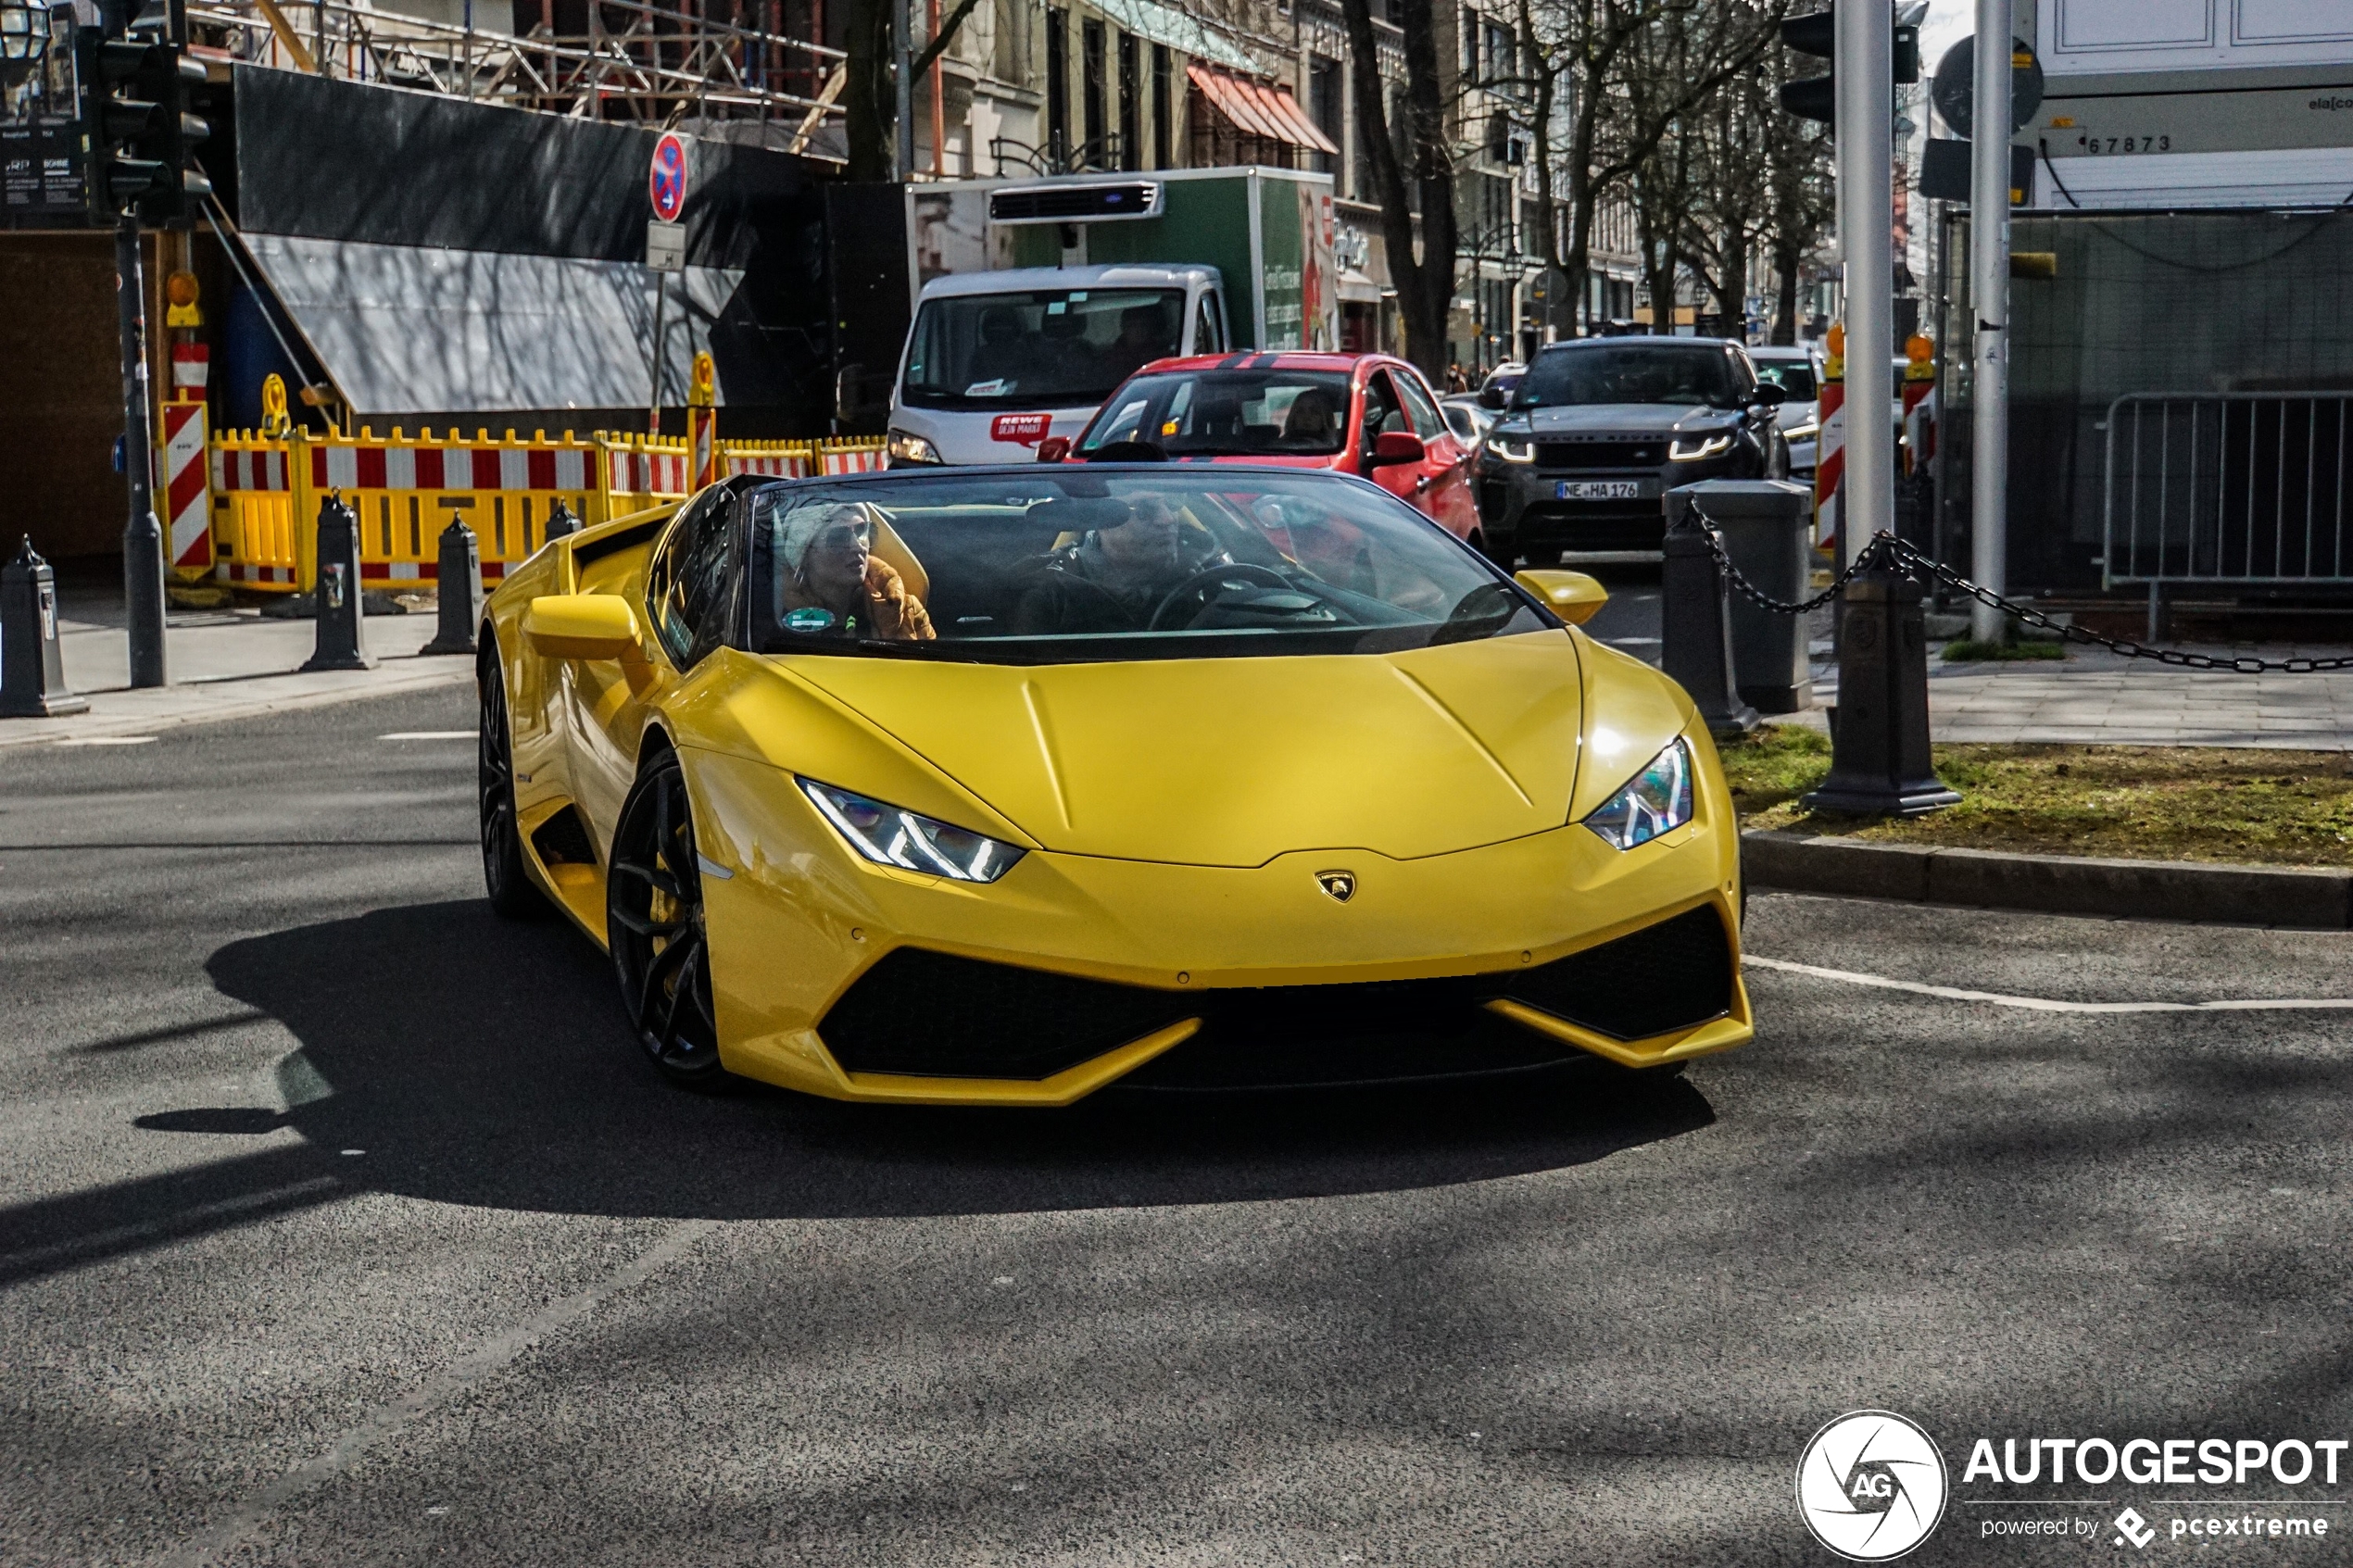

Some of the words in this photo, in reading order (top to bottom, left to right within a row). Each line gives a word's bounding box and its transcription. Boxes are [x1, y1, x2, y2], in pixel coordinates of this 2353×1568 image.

[1000, 416, 1044, 424] REWE
[1564, 483, 1581, 496] NE
[1590, 483, 1608, 496] HA
[1611, 483, 1636, 497] 176
